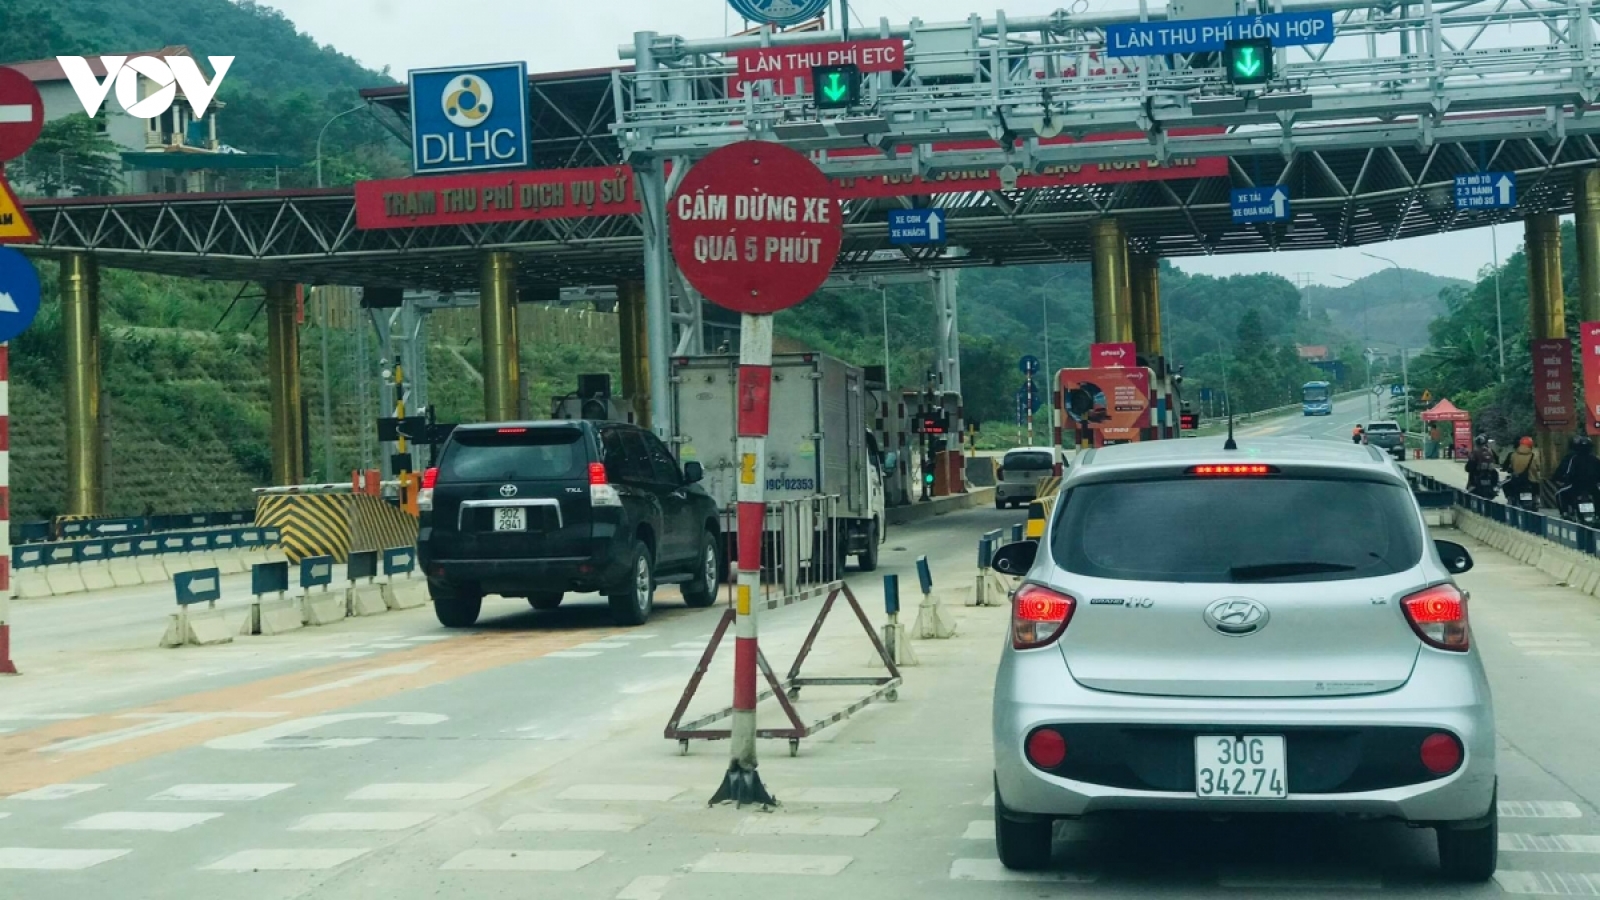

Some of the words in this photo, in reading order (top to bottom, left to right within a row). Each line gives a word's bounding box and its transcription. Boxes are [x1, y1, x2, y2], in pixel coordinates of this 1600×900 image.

[1115, 28, 1153, 49] LÀN
[1158, 26, 1196, 46] THU
[1202, 20, 1233, 42] PHÍ
[1239, 16, 1280, 40] HỖN
[1286, 19, 1325, 40] HỢP
[745, 51, 781, 73] LÀN
[785, 52, 821, 70] THU
[827, 45, 857, 65] PHÍ
[863, 47, 895, 65] ETC
[422, 128, 516, 165] DLHC
[1456, 176, 1467, 185] XE
[383, 190, 435, 221] TRẠM
[441, 187, 477, 213] THU
[482, 180, 513, 211] PHÍ
[520, 183, 564, 213] DỊCH
[571, 180, 595, 211] VỤ
[600, 168, 628, 205] SỬ
[678, 185, 728, 221] CẤM
[735, 187, 797, 222] DỪNG
[802, 197, 830, 223] XE
[1238, 194, 1248, 203] XE
[1457, 198, 1468, 206] XE
[895, 215, 905, 224] XE
[1233, 208, 1243, 217] XE
[891, 228, 901, 237] XE
[694, 228, 738, 264] QUÁ
[744, 236, 758, 262] 5
[764, 231, 822, 264] PHÚT
[500, 508, 520, 519] 30Z
[500, 519, 521, 530] 2941
[1217, 738, 1264, 765] 30G
[1199, 767, 1284, 796] 342.74
